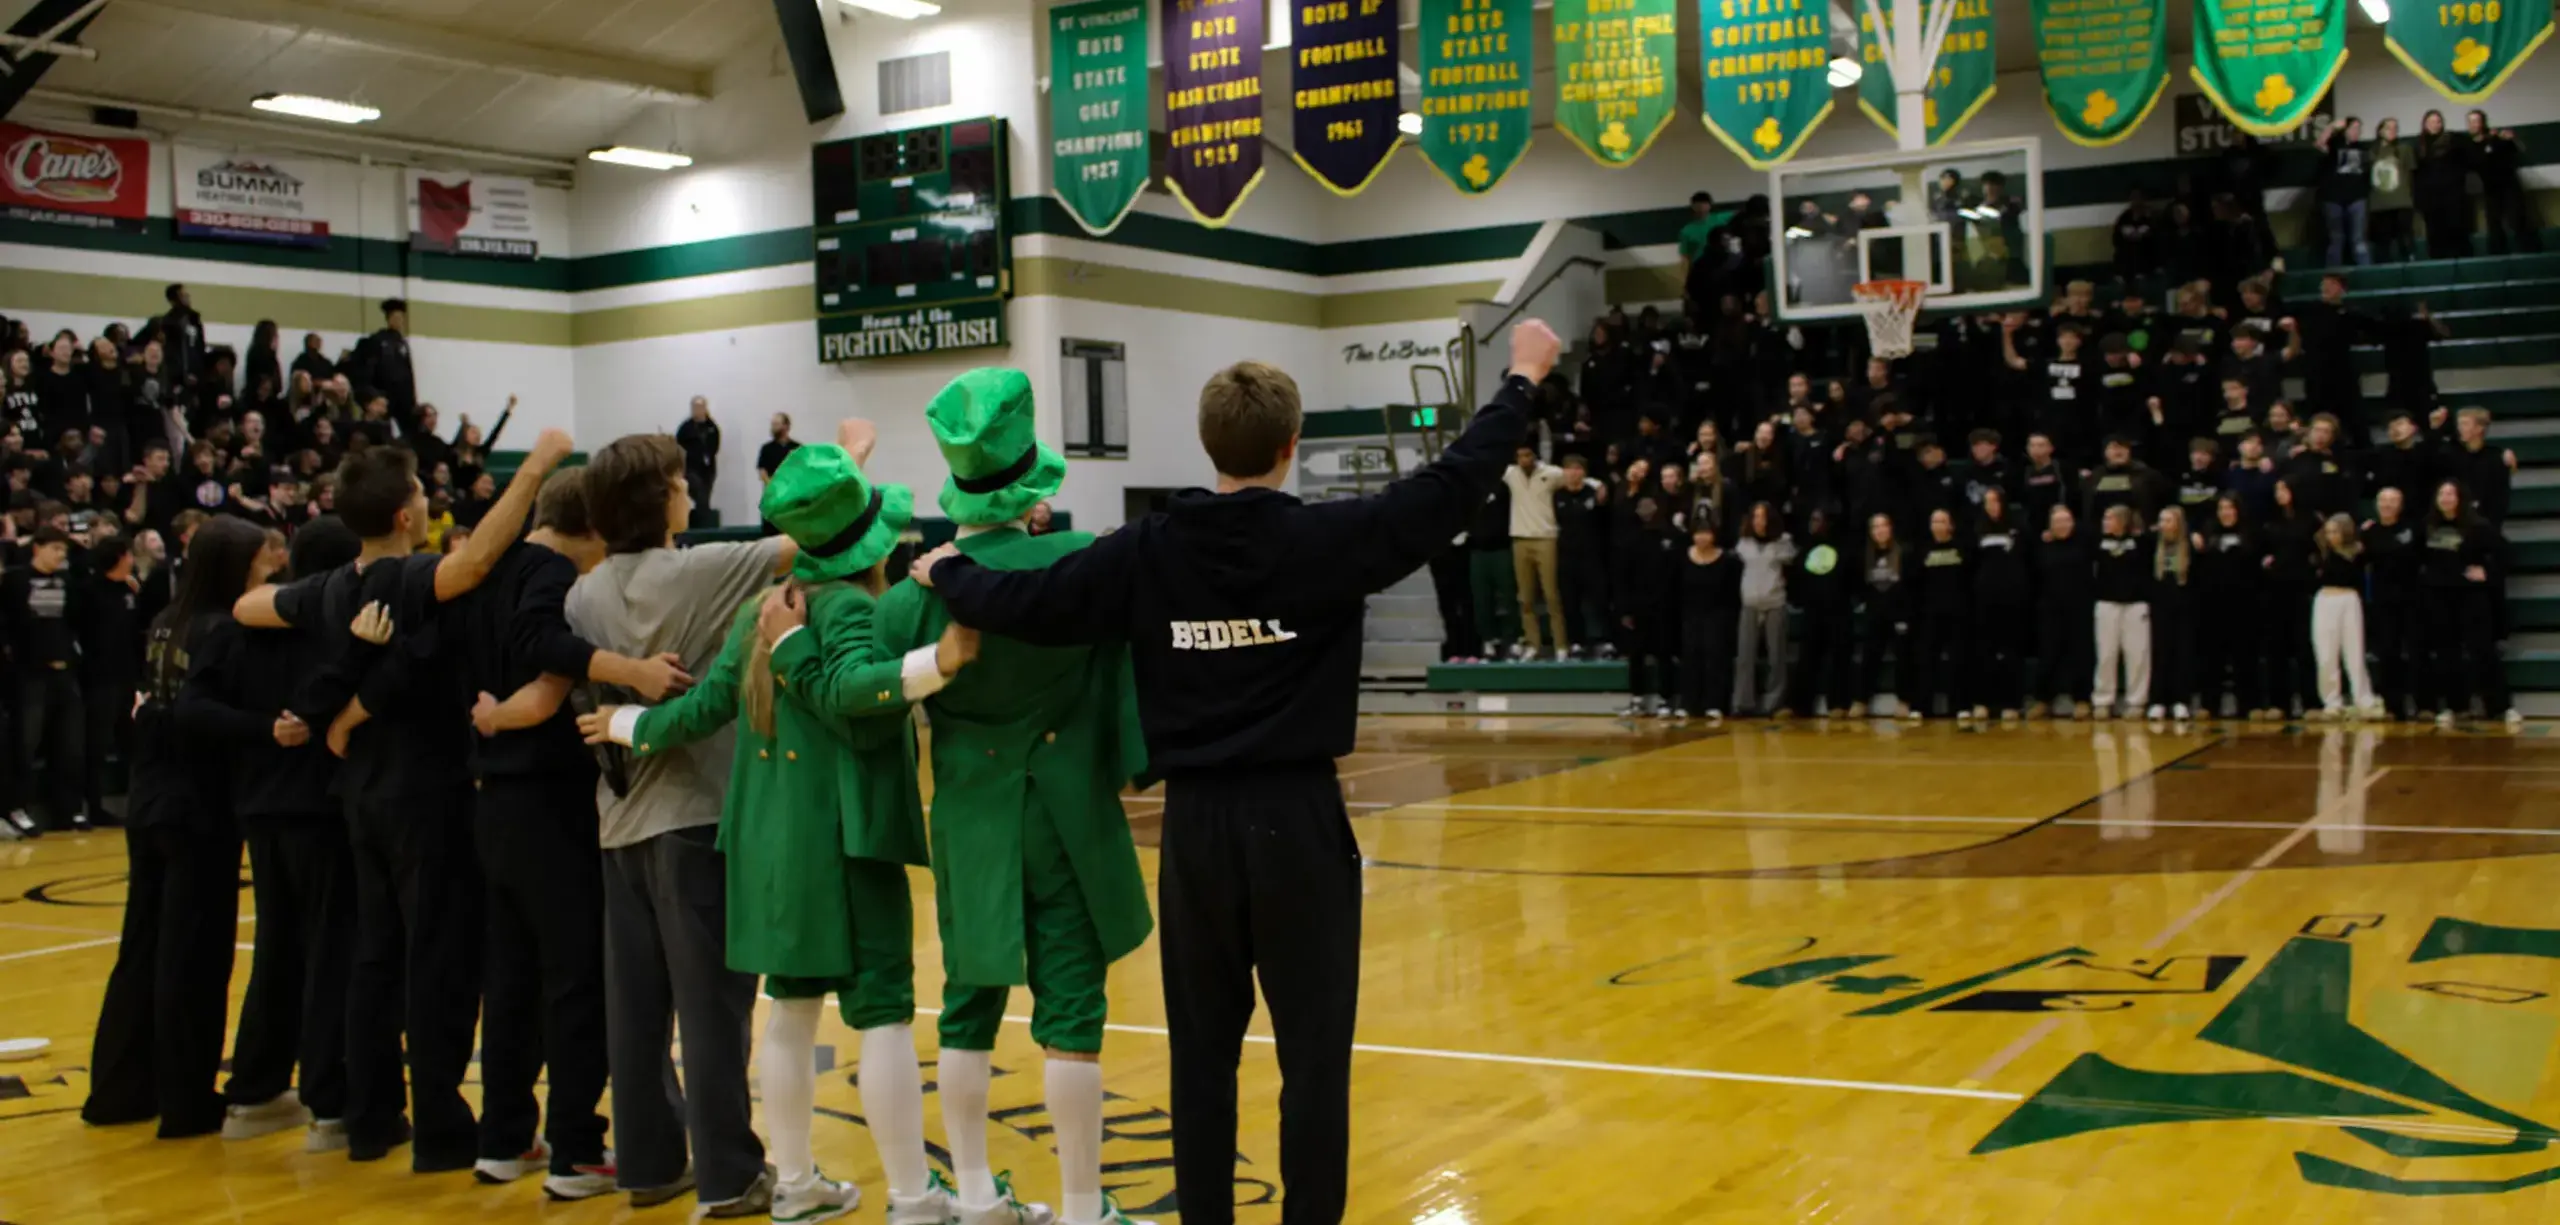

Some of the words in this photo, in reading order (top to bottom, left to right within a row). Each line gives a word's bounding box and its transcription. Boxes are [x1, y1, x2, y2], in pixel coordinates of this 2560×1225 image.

[1447, 10, 1503, 34] BOYS
[2438, 1, 2501, 27] 1980
[1191, 16, 1237, 39] BOYS
[1710, 15, 1823, 47] SOFTBALL
[1300, 36, 1387, 68] FOOTBALL
[1442, 32, 1508, 58] STATE
[1189, 46, 1241, 71] STATE
[1568, 56, 1662, 81] FOOTBALL
[1708, 46, 1826, 78] CHAMPIONS
[1073, 66, 1126, 90] STATE
[1429, 62, 1519, 86] FOOTBALL
[1168, 76, 1261, 111] BASKETBALL
[1295, 79, 1395, 110] CHAMPIONS
[1422, 88, 1529, 115] CHAMPIONS
[1561, 76, 1663, 102] CHAMPIONS
[1738, 79, 1790, 105] 1979
[1079, 100, 1120, 122] GOLF
[1055, 130, 1144, 156] CHAMPIONS
[1171, 117, 1262, 148] CHAMPIONS
[197, 169, 304, 197] SUMMIT
[862, 314, 901, 331] Home
[908, 309, 924, 326] of
[929, 307, 952, 323] the
[823, 325, 932, 361] FIGHTING
[935, 317, 998, 349] IRISH
[1342, 342, 1374, 365] The
[1170, 618, 1298, 650] BEDELL
